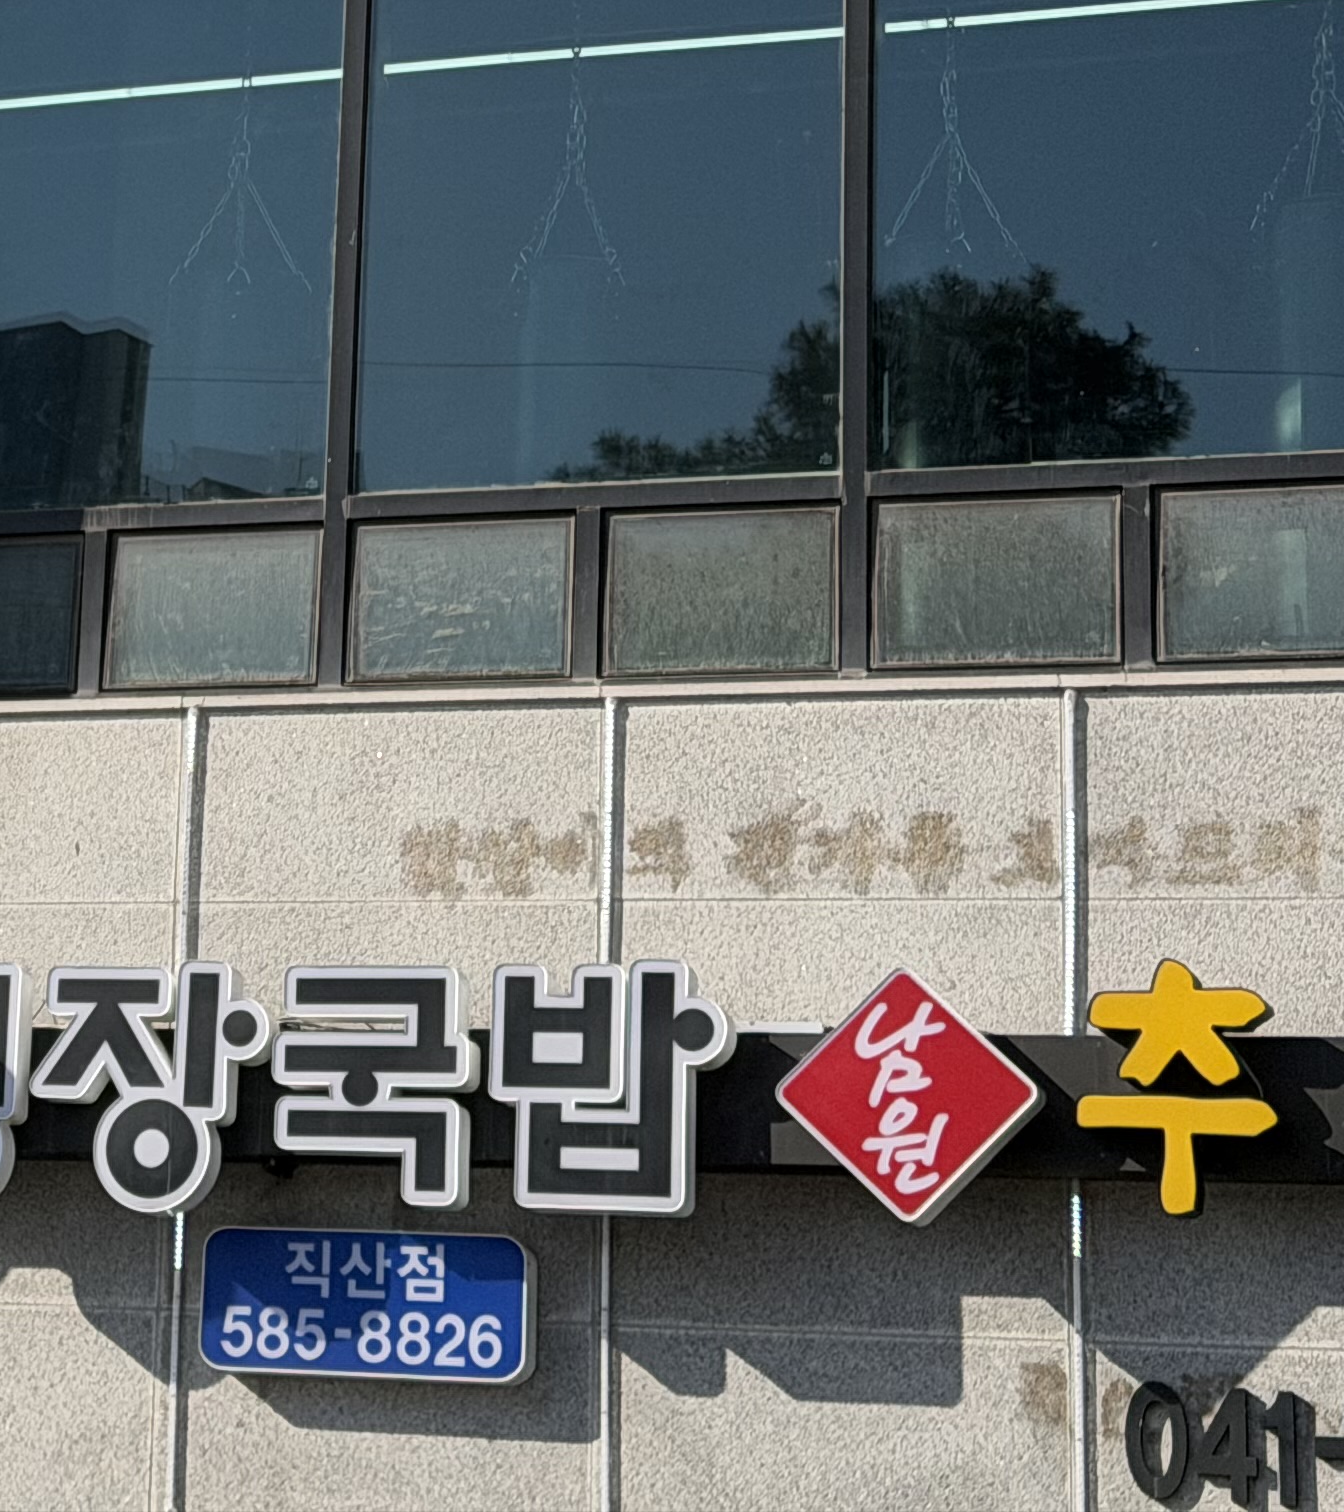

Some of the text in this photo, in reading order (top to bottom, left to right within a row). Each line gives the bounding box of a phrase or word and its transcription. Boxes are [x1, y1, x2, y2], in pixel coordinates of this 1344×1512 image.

[854, 1000, 950, 1195] 남원
[285, 1240, 447, 1303] 직산점
[219, 1304, 504, 1369] 585-8826
